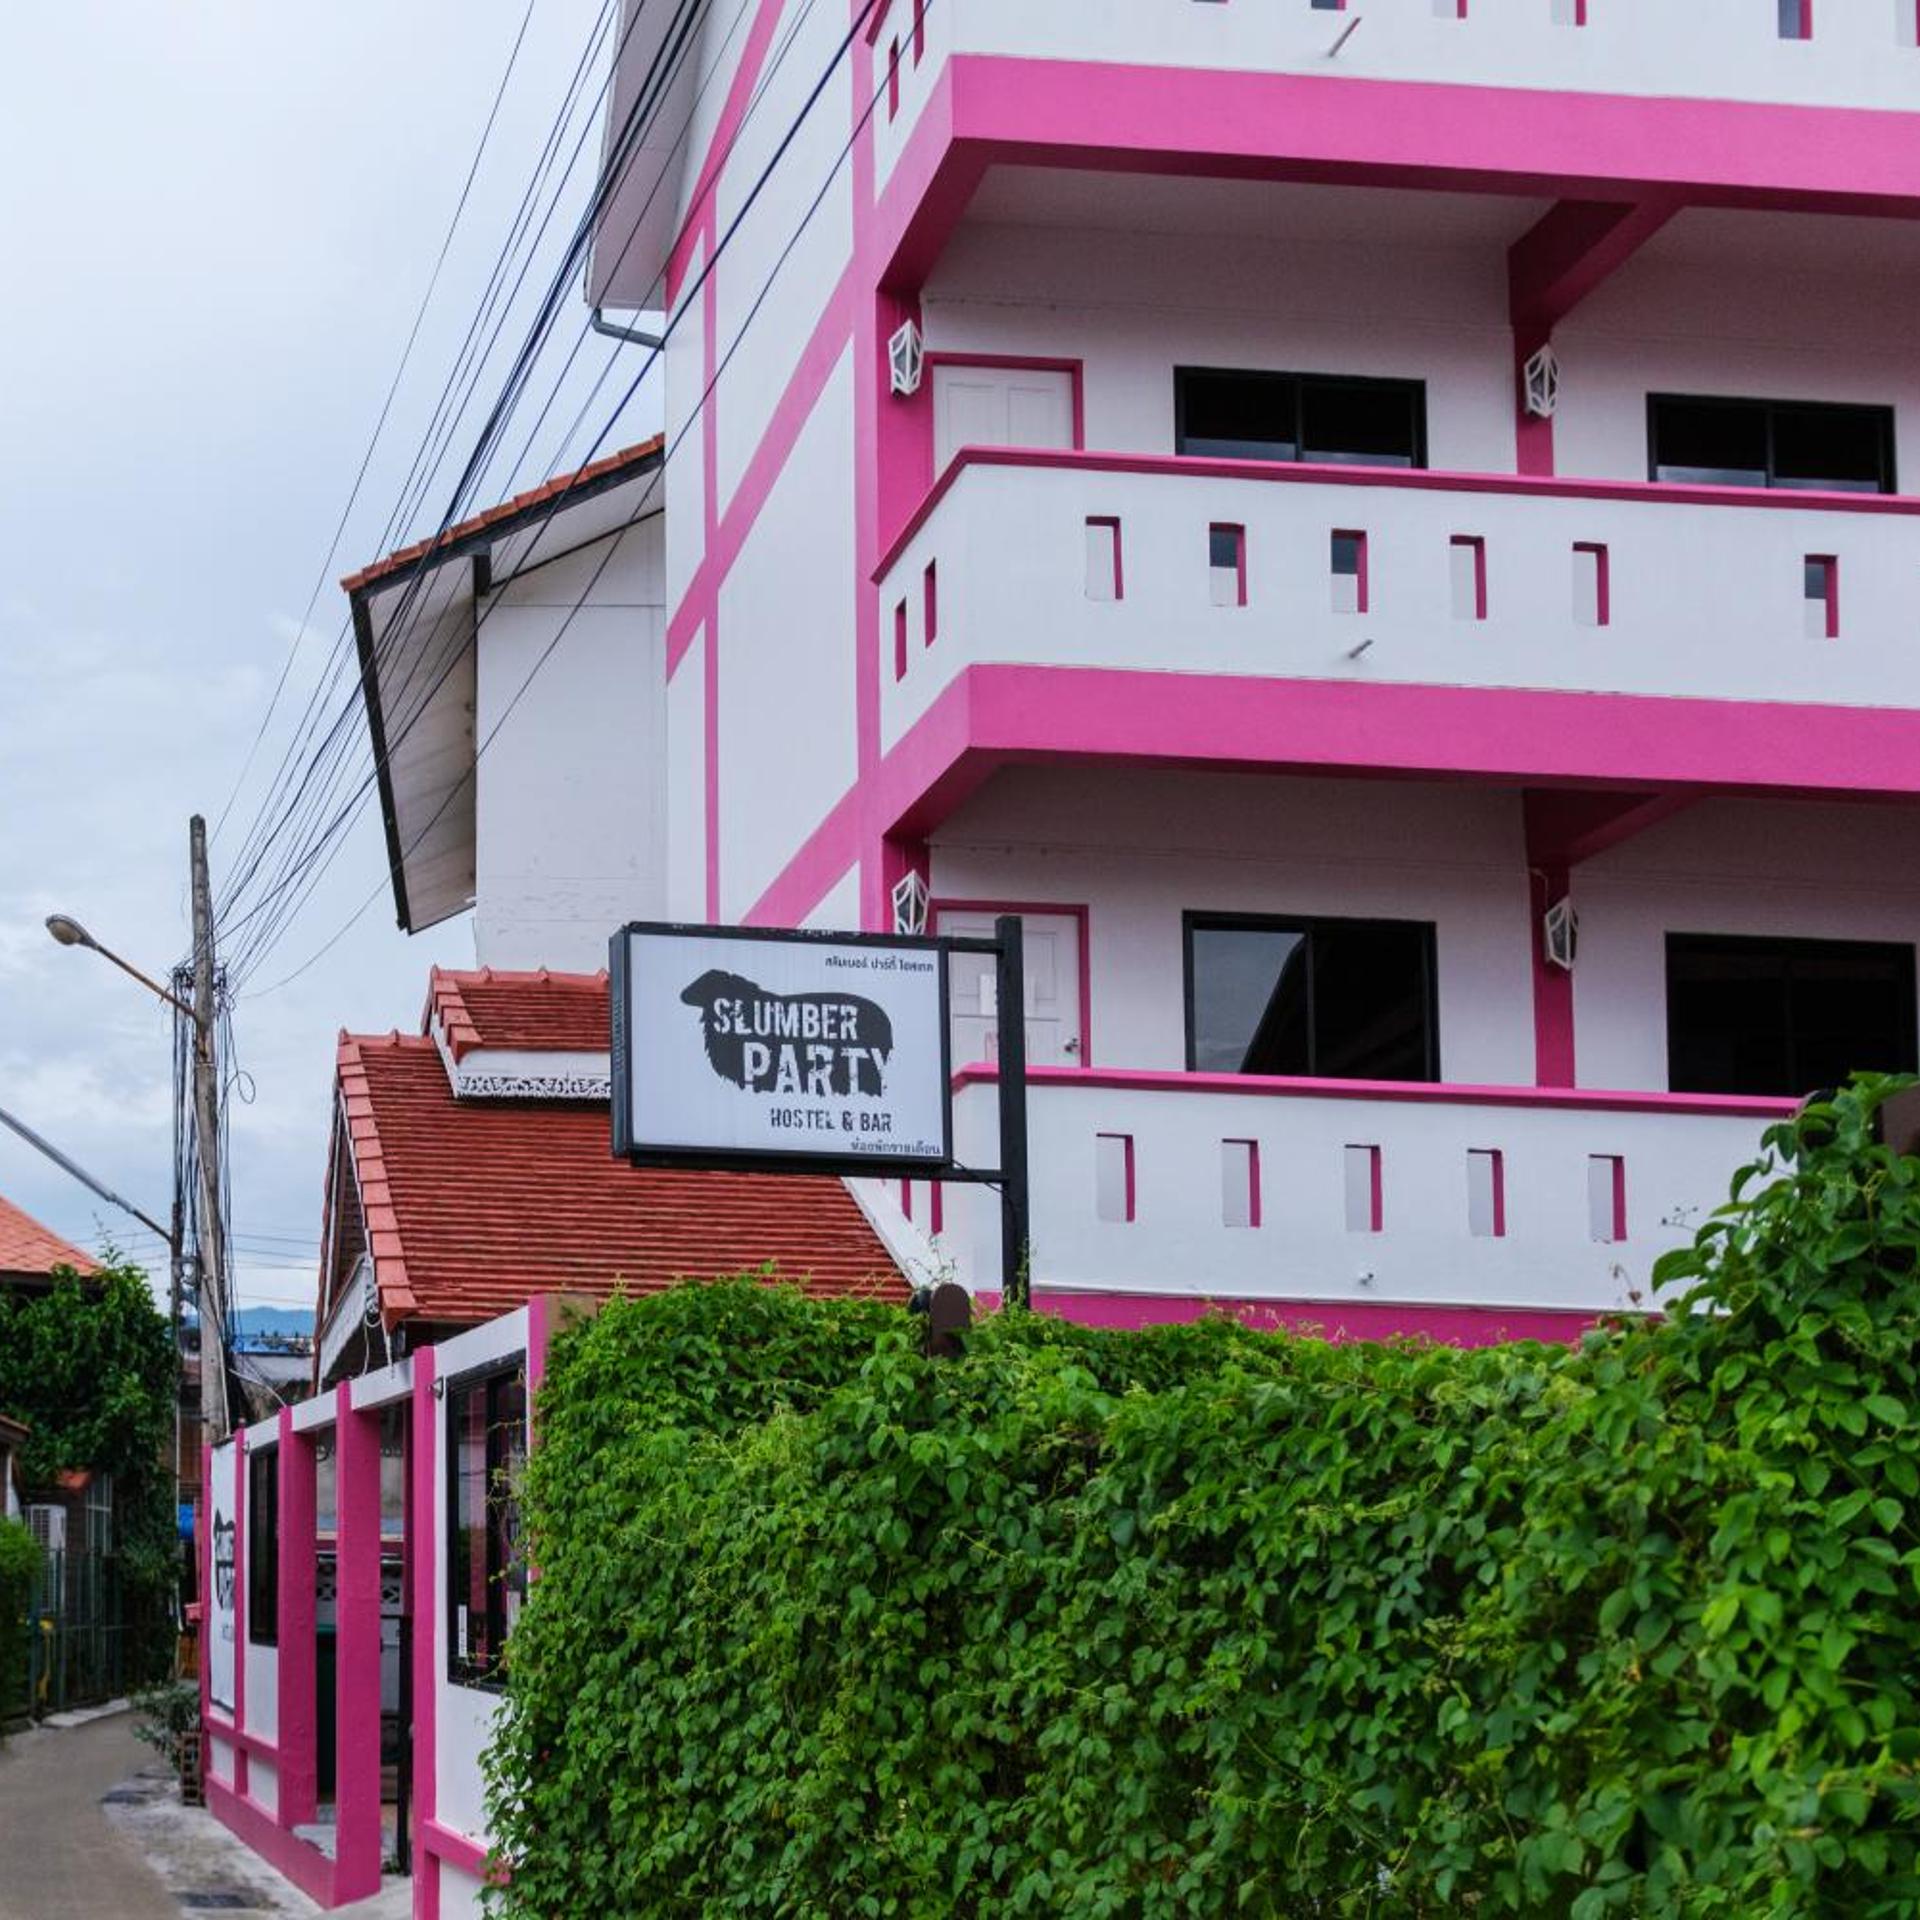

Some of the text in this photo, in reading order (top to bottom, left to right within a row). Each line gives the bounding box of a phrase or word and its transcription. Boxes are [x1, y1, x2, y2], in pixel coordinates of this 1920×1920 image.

[713, 998, 857, 1040] SLUMBER
[743, 1042, 895, 1098] PARTY
[770, 1107, 892, 1133] HOSTEL & BAR
